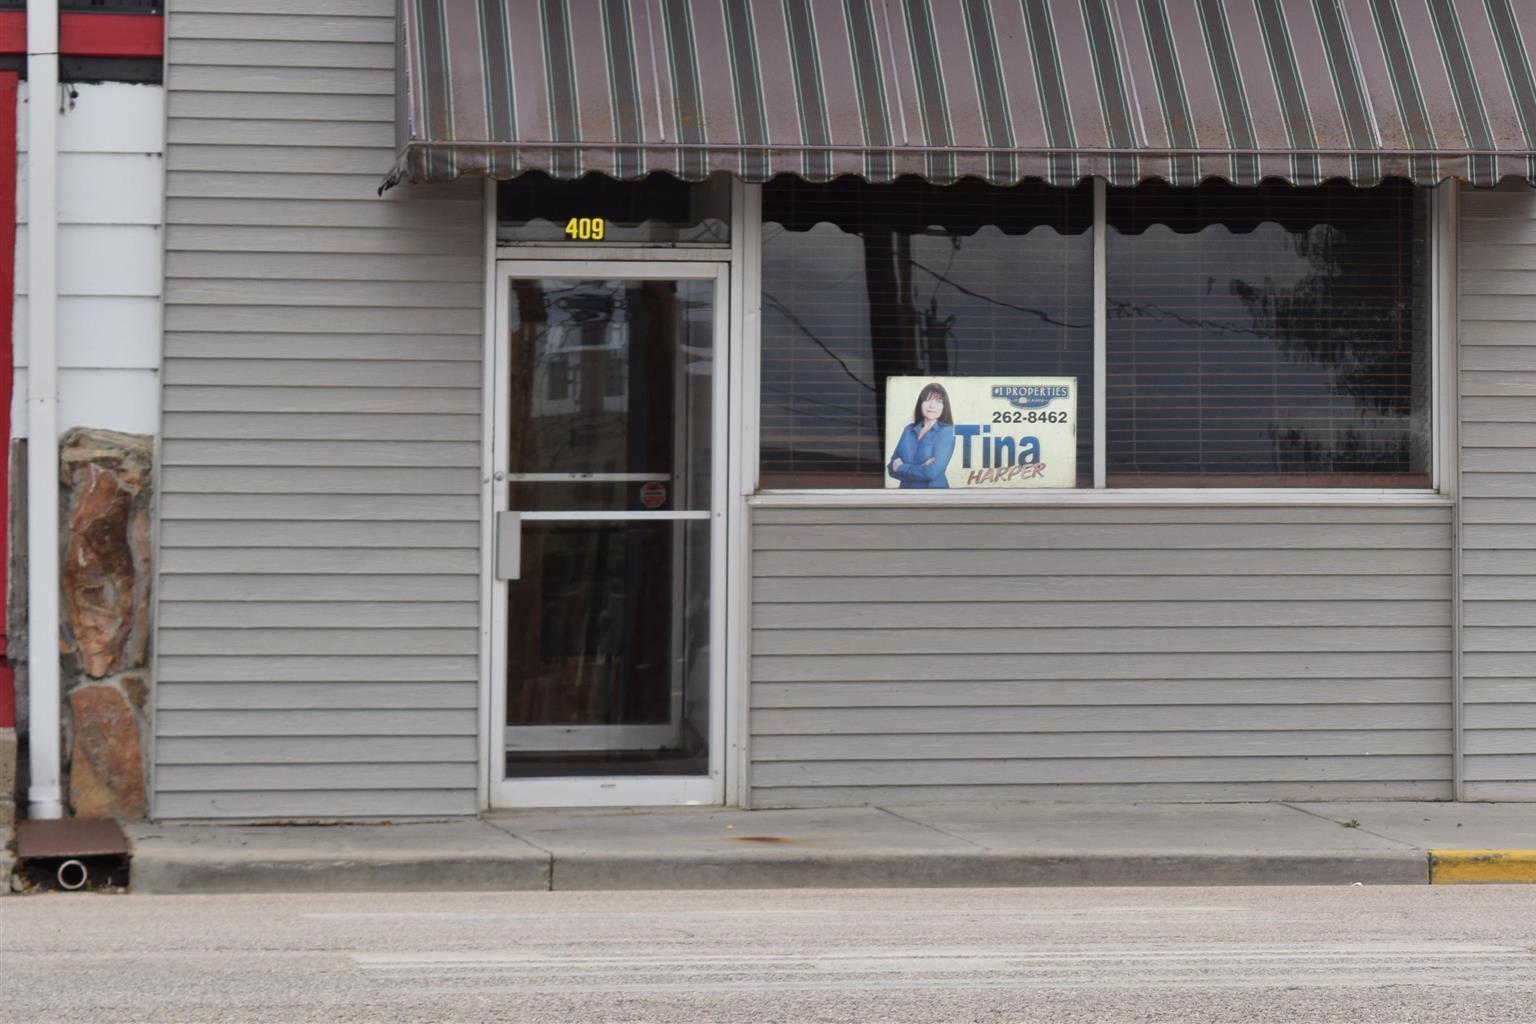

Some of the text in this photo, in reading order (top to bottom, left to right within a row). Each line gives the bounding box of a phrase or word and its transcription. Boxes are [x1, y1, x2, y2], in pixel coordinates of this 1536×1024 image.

[566, 217, 604, 240] 409
[1005, 387, 1067, 396] PROPERTIES
[992, 411, 1068, 424] 262-8462
[954, 424, 1040, 469] Tina
[967, 462, 1047, 485] HARPER
